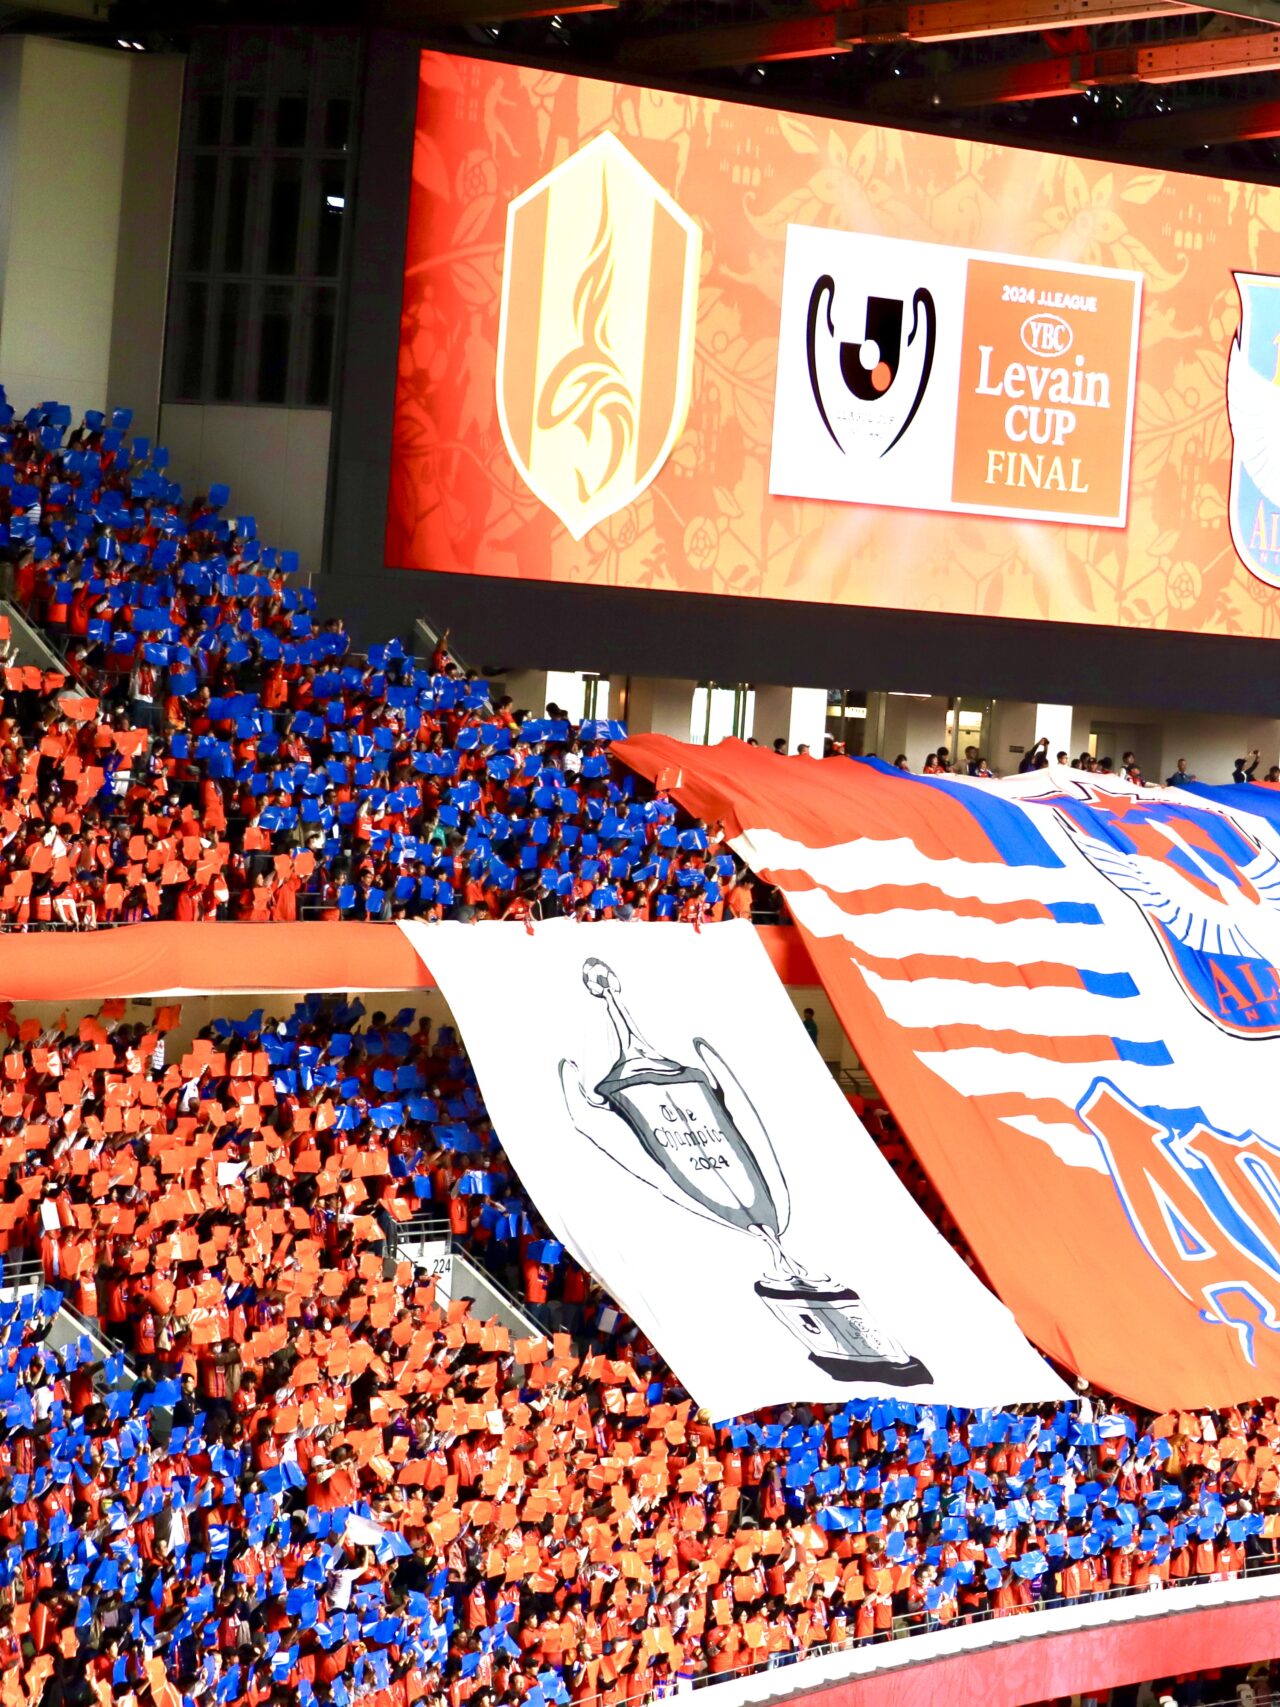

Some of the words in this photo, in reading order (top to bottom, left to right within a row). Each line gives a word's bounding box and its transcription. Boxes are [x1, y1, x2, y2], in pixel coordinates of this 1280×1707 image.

[1001, 284, 1035, 304] 2024
[1037, 290, 1098, 313] J.LEAGUE
[1029, 320, 1066, 351] YBC
[975, 345, 1111, 408] Levain
[1004, 404, 1077, 446] CUP
[984, 448, 1090, 494] FINAL
[689, 1154, 730, 1171] 2024
[433, 1258, 451, 1274] 224
